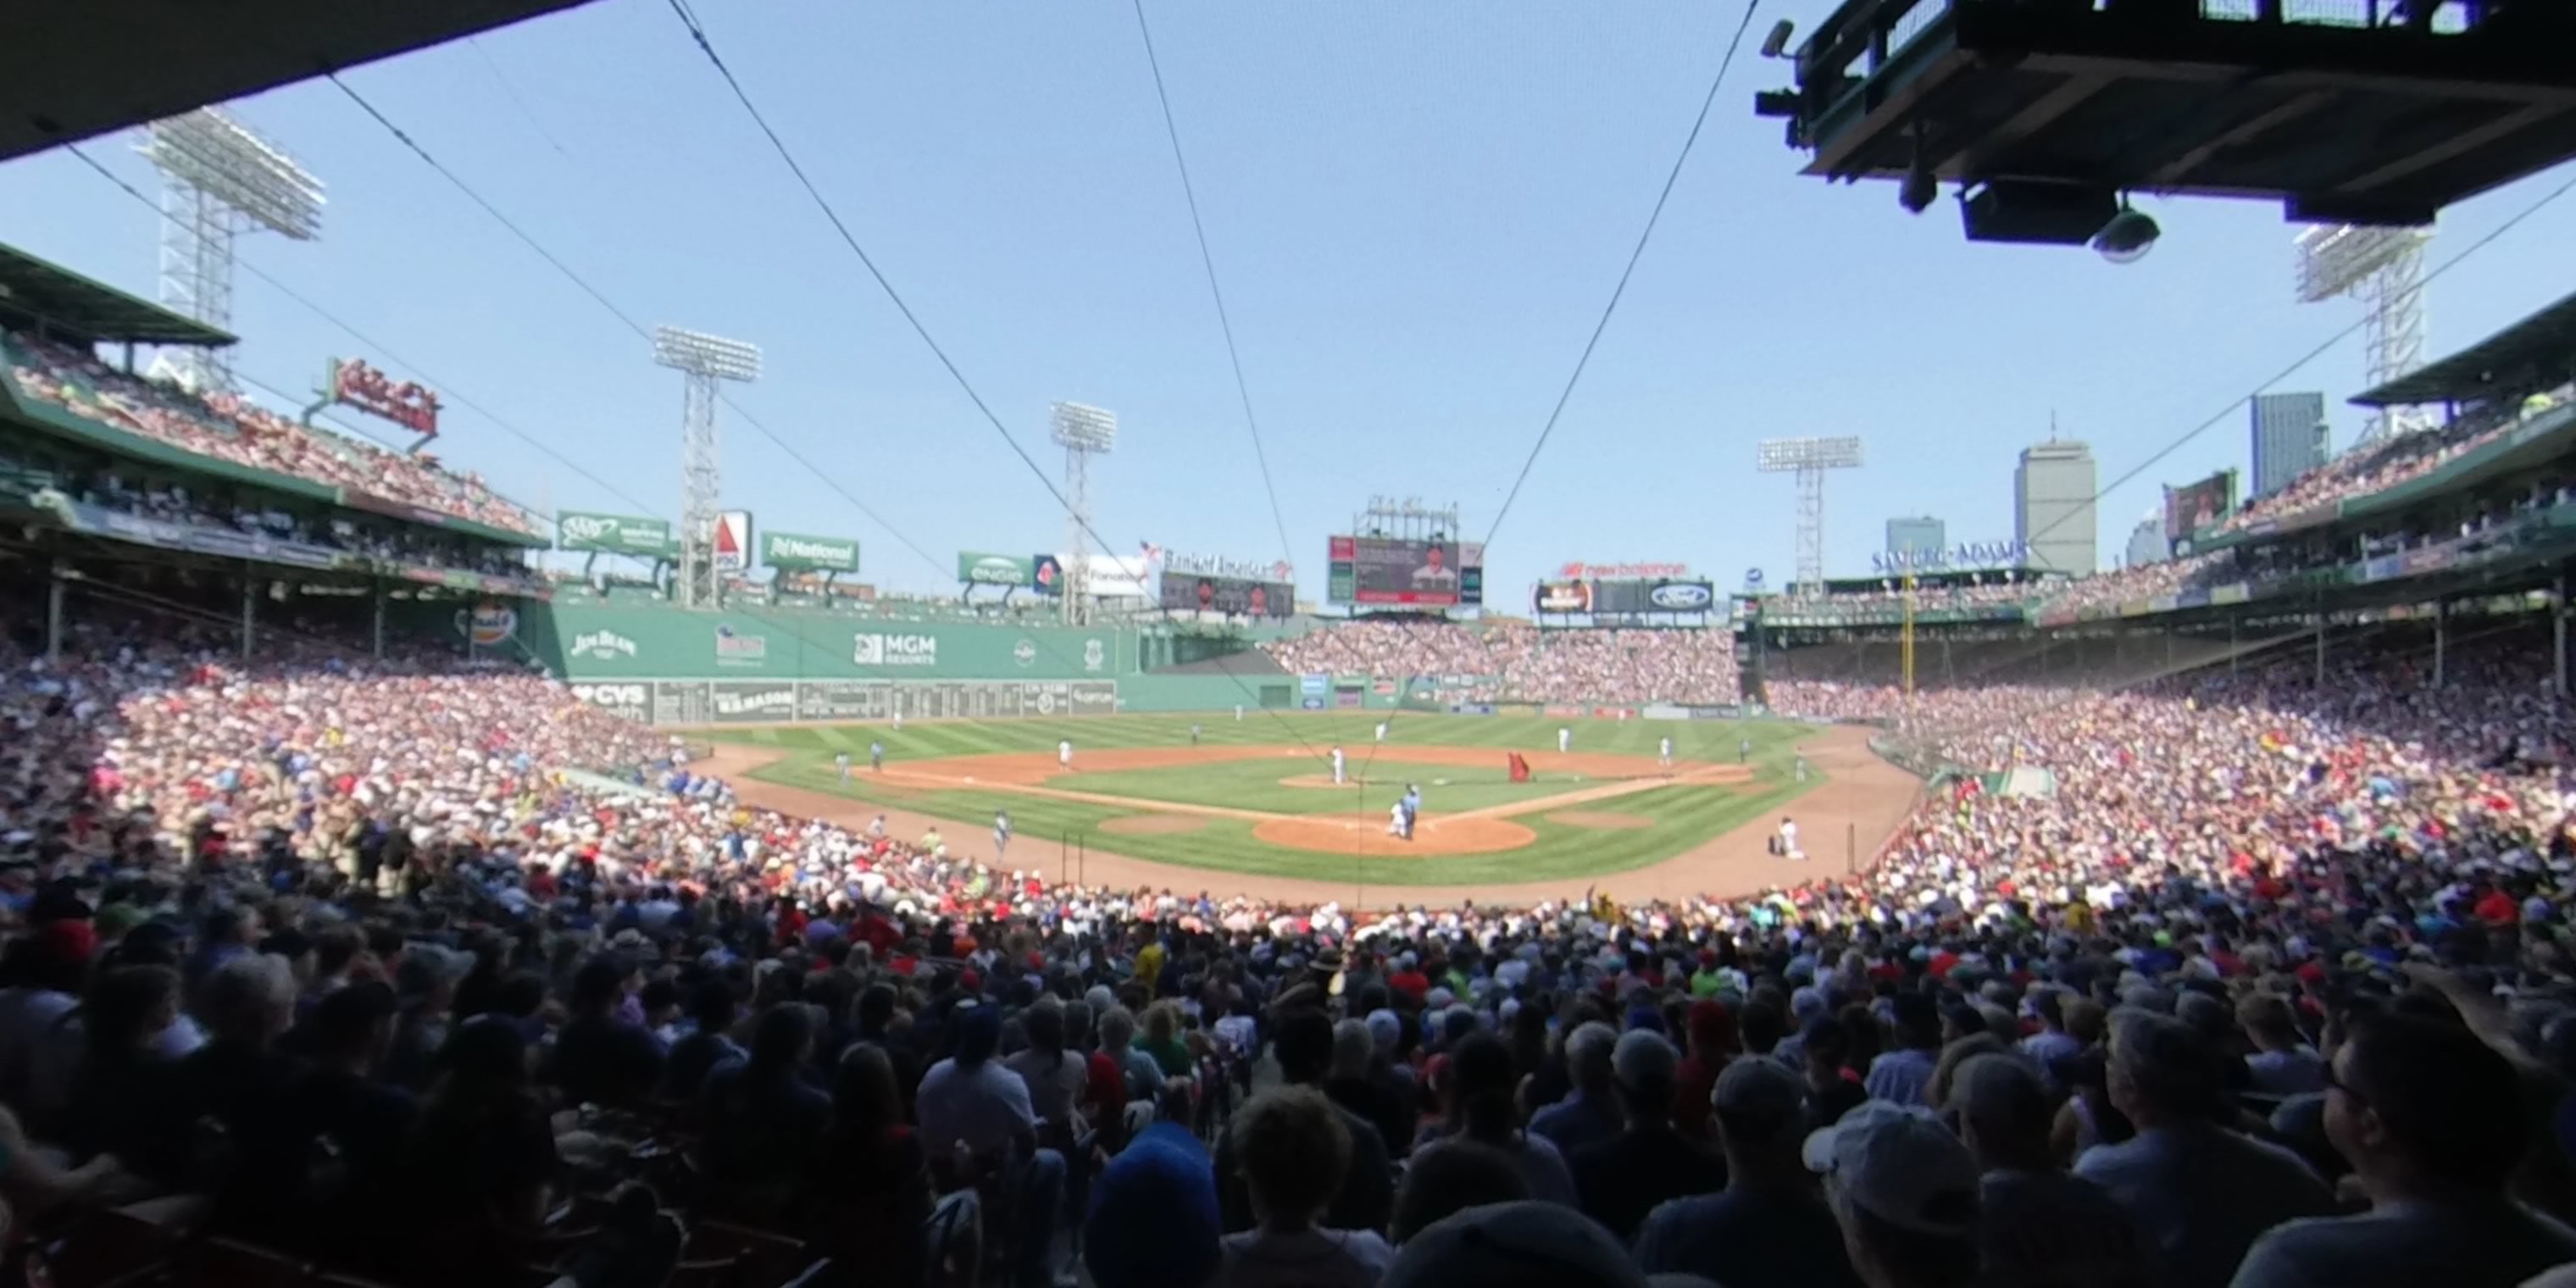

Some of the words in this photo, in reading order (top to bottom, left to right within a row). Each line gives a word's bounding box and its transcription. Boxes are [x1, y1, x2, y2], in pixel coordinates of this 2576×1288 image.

[791, 540, 852, 560] National
[1164, 549, 1198, 572] Bank
[1213, 555, 1270, 580] America
[886, 634, 935, 653] MGM
[595, 684, 645, 704] CVS
